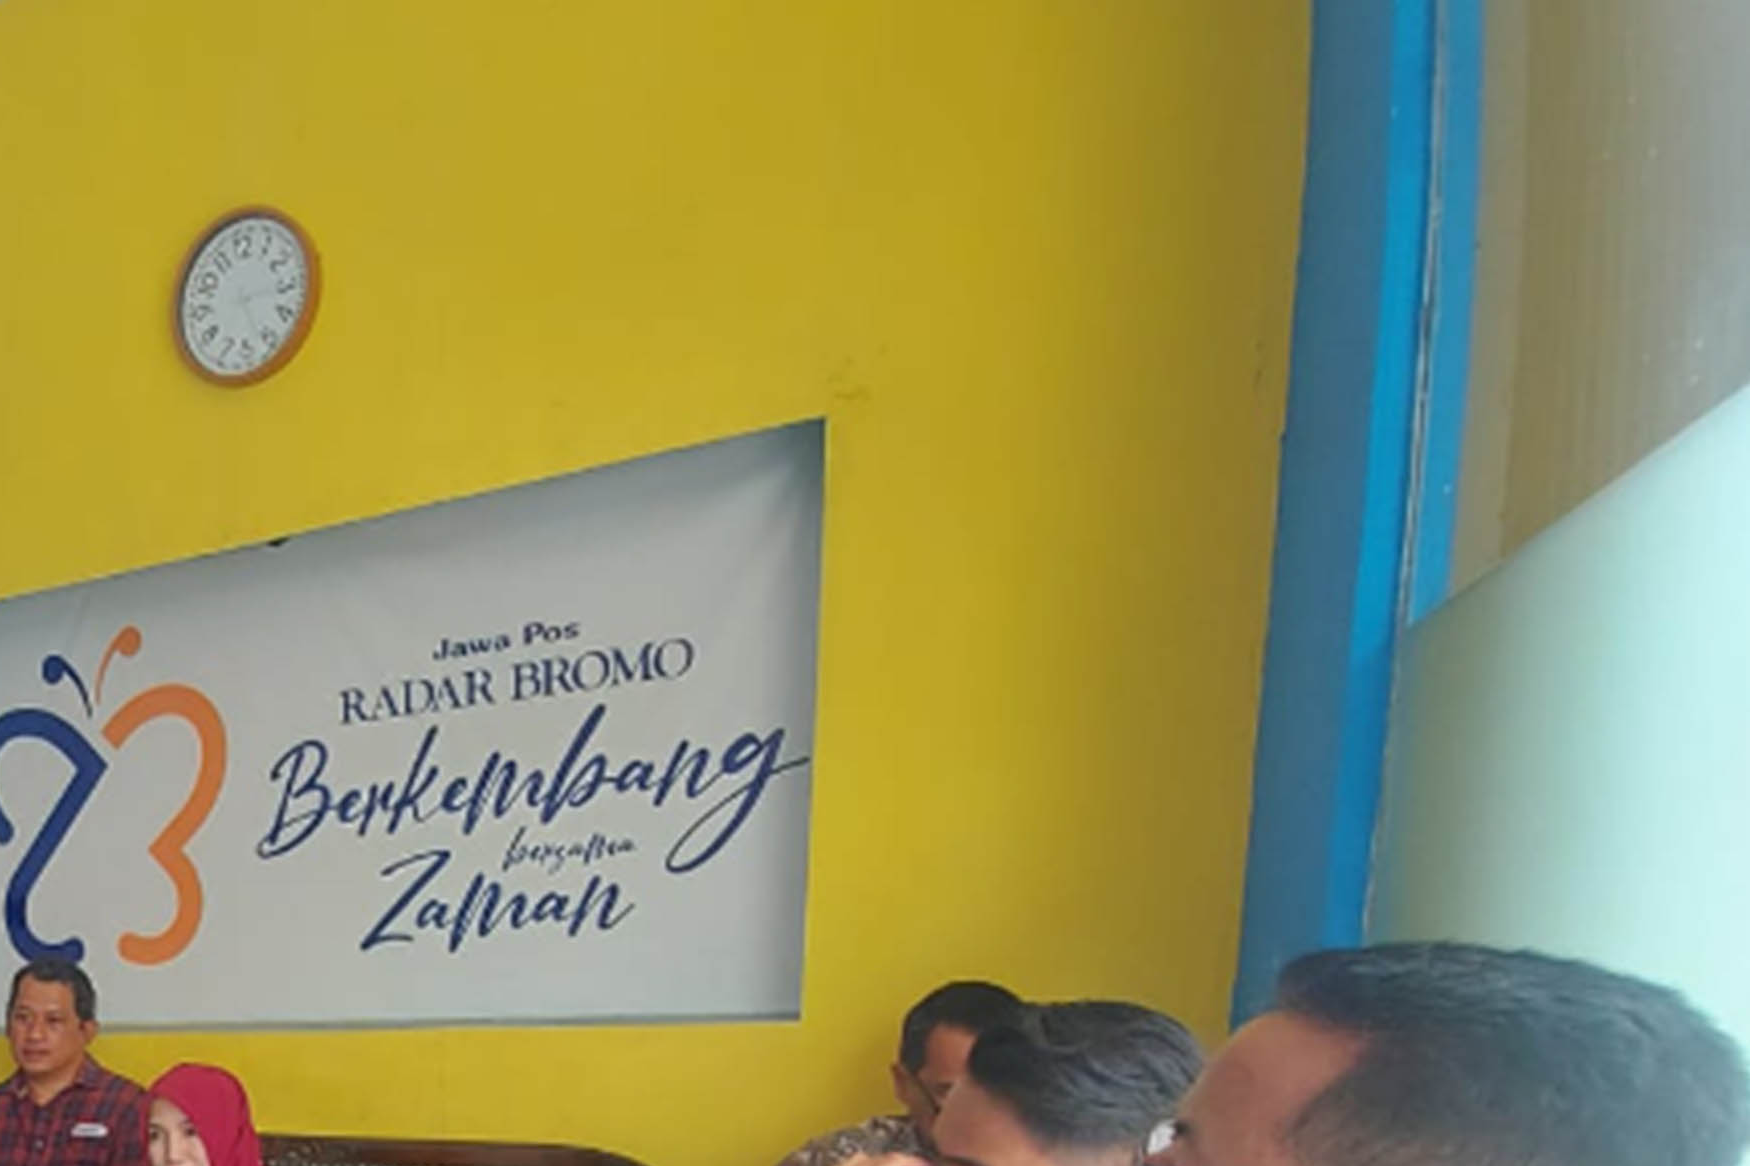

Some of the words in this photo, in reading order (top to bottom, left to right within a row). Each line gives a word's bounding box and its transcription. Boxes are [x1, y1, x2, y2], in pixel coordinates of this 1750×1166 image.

[233, 234, 253, 258] 12
[259, 234, 273, 257] 1
[213, 250, 233, 274] 11
[269, 250, 291, 273] 2
[197, 271, 219, 299] 10
[276, 275, 296, 294] 3
[275, 304, 294, 324] 4
[201, 324, 220, 346] 8
[219, 336, 237, 358] 7
[432, 632, 511, 661] Jawa
[521, 621, 581, 646] Pos
[339, 667, 496, 725] RADAR
[511, 637, 695, 701] BROMO
[256, 703, 811, 874] Berkembang
[502, 827, 638, 874] bersama
[359, 849, 636, 953] Zaman
